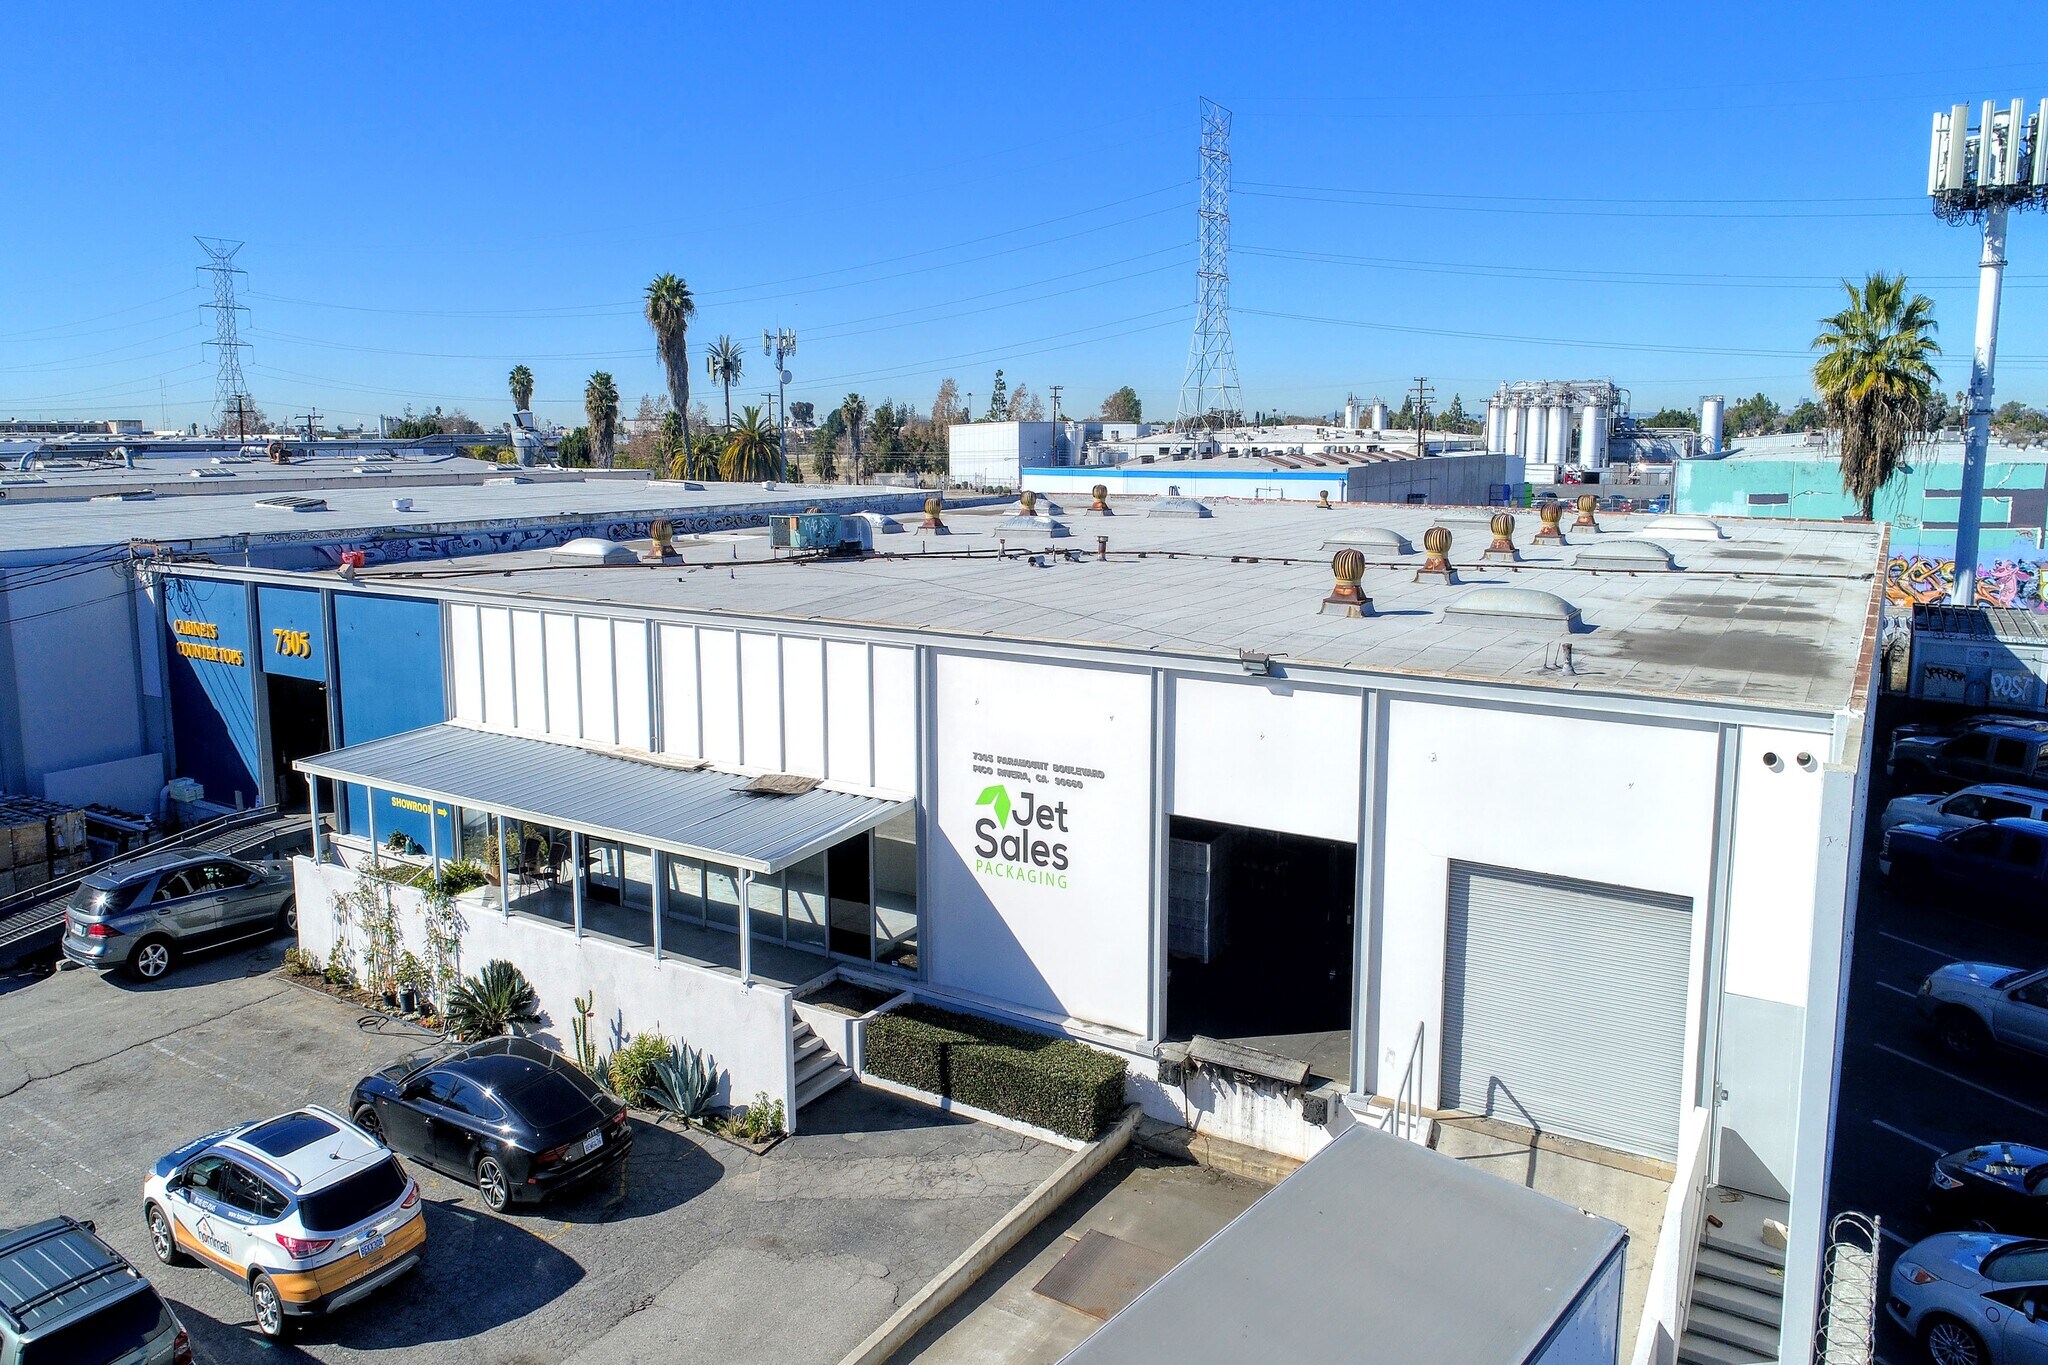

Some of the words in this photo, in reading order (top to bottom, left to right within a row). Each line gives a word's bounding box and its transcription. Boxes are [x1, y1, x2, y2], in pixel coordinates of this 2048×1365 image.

[174, 620, 217, 639] CABINETS
[273, 628, 309, 658] 7305
[973, 752, 994, 763] 7305
[997, 756, 1049, 771] PARAMOUNT
[1053, 764, 1105, 779] BOULEVARD
[973, 764, 994, 776] PICO
[997, 768, 1031, 783] RIVERA,
[1055, 777, 1084, 789] 90660
[1012, 791, 1069, 833] Jet
[974, 817, 1069, 871] Sales
[976, 859, 1067, 889] PACKAGING
